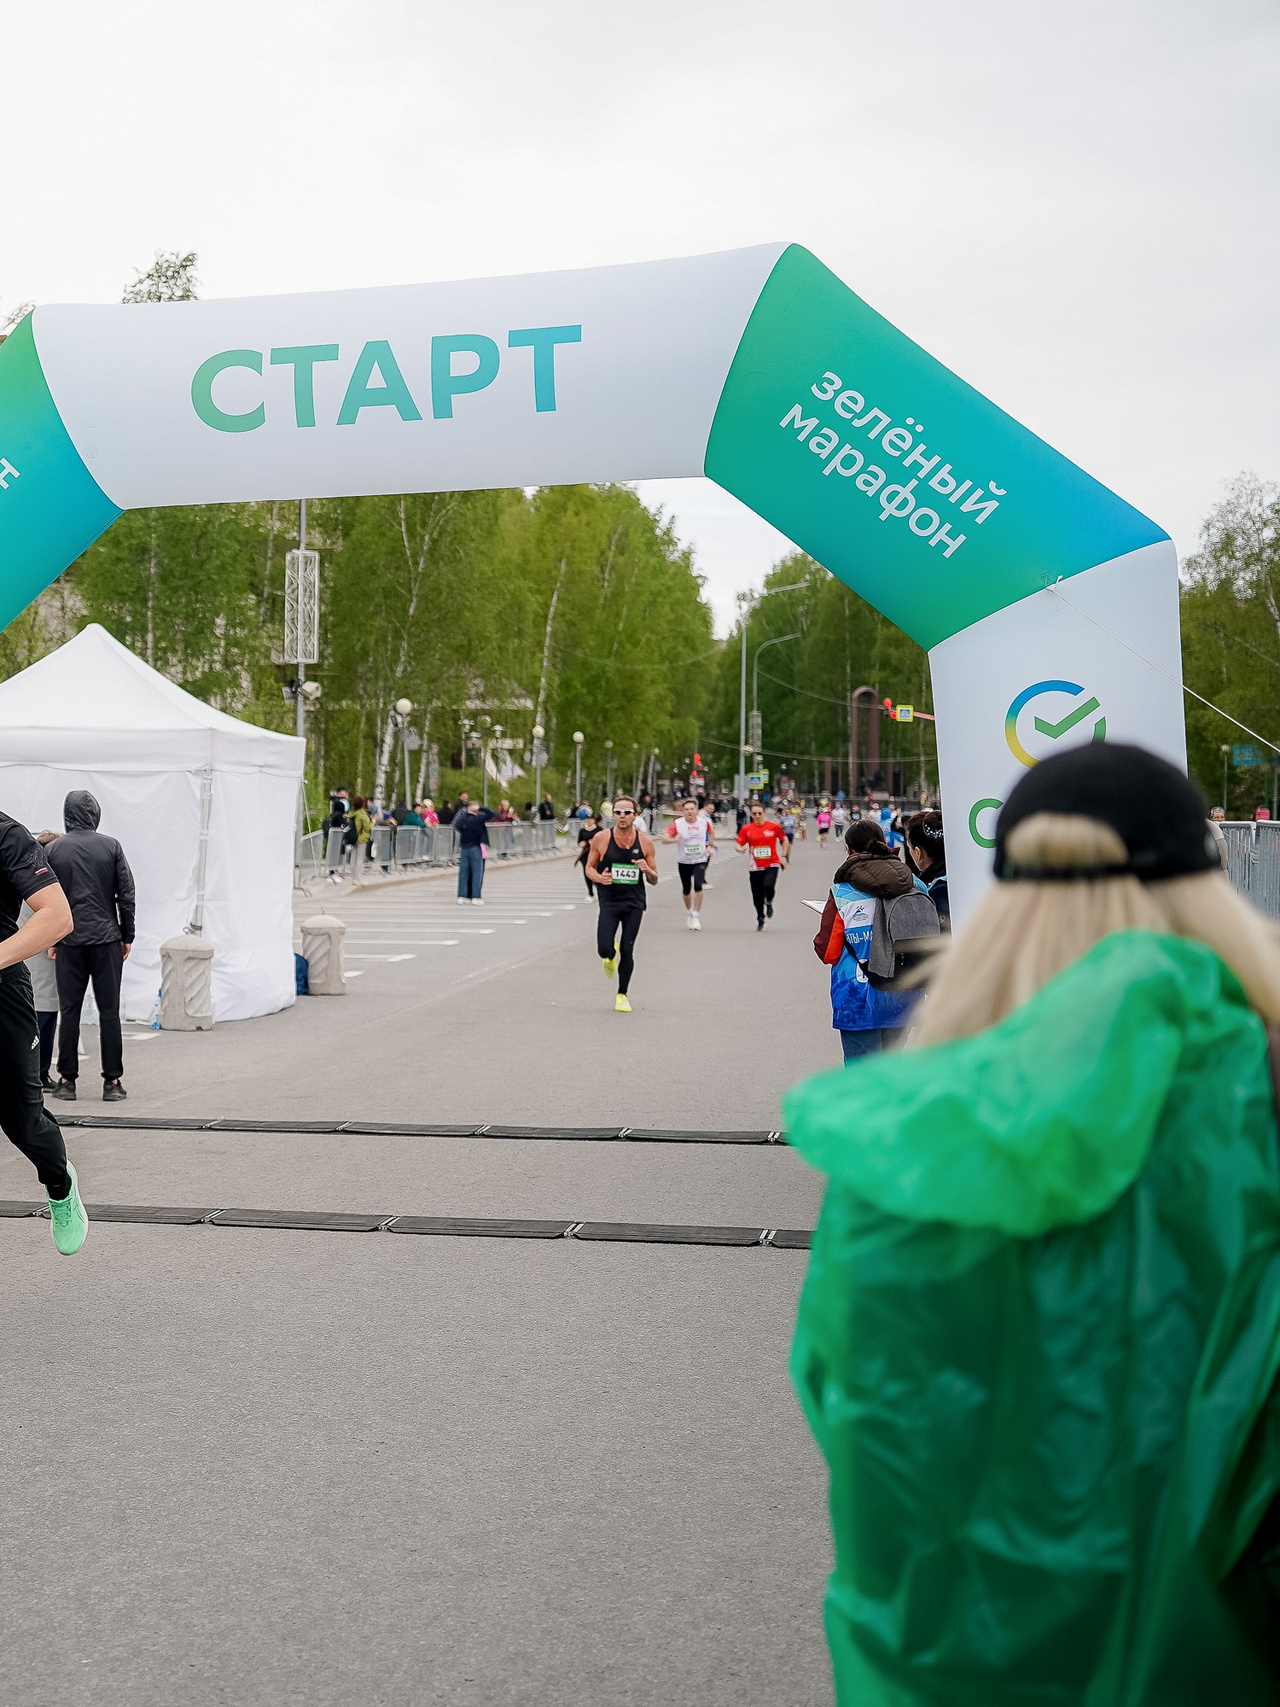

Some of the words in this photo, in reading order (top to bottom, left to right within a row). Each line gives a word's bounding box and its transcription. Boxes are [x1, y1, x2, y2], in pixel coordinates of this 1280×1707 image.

[191, 324, 582, 433] СТАРТ
[778, 403, 967, 559] марафон
[810, 370, 1008, 525] зелёный
[615, 870, 637, 879] 1443
